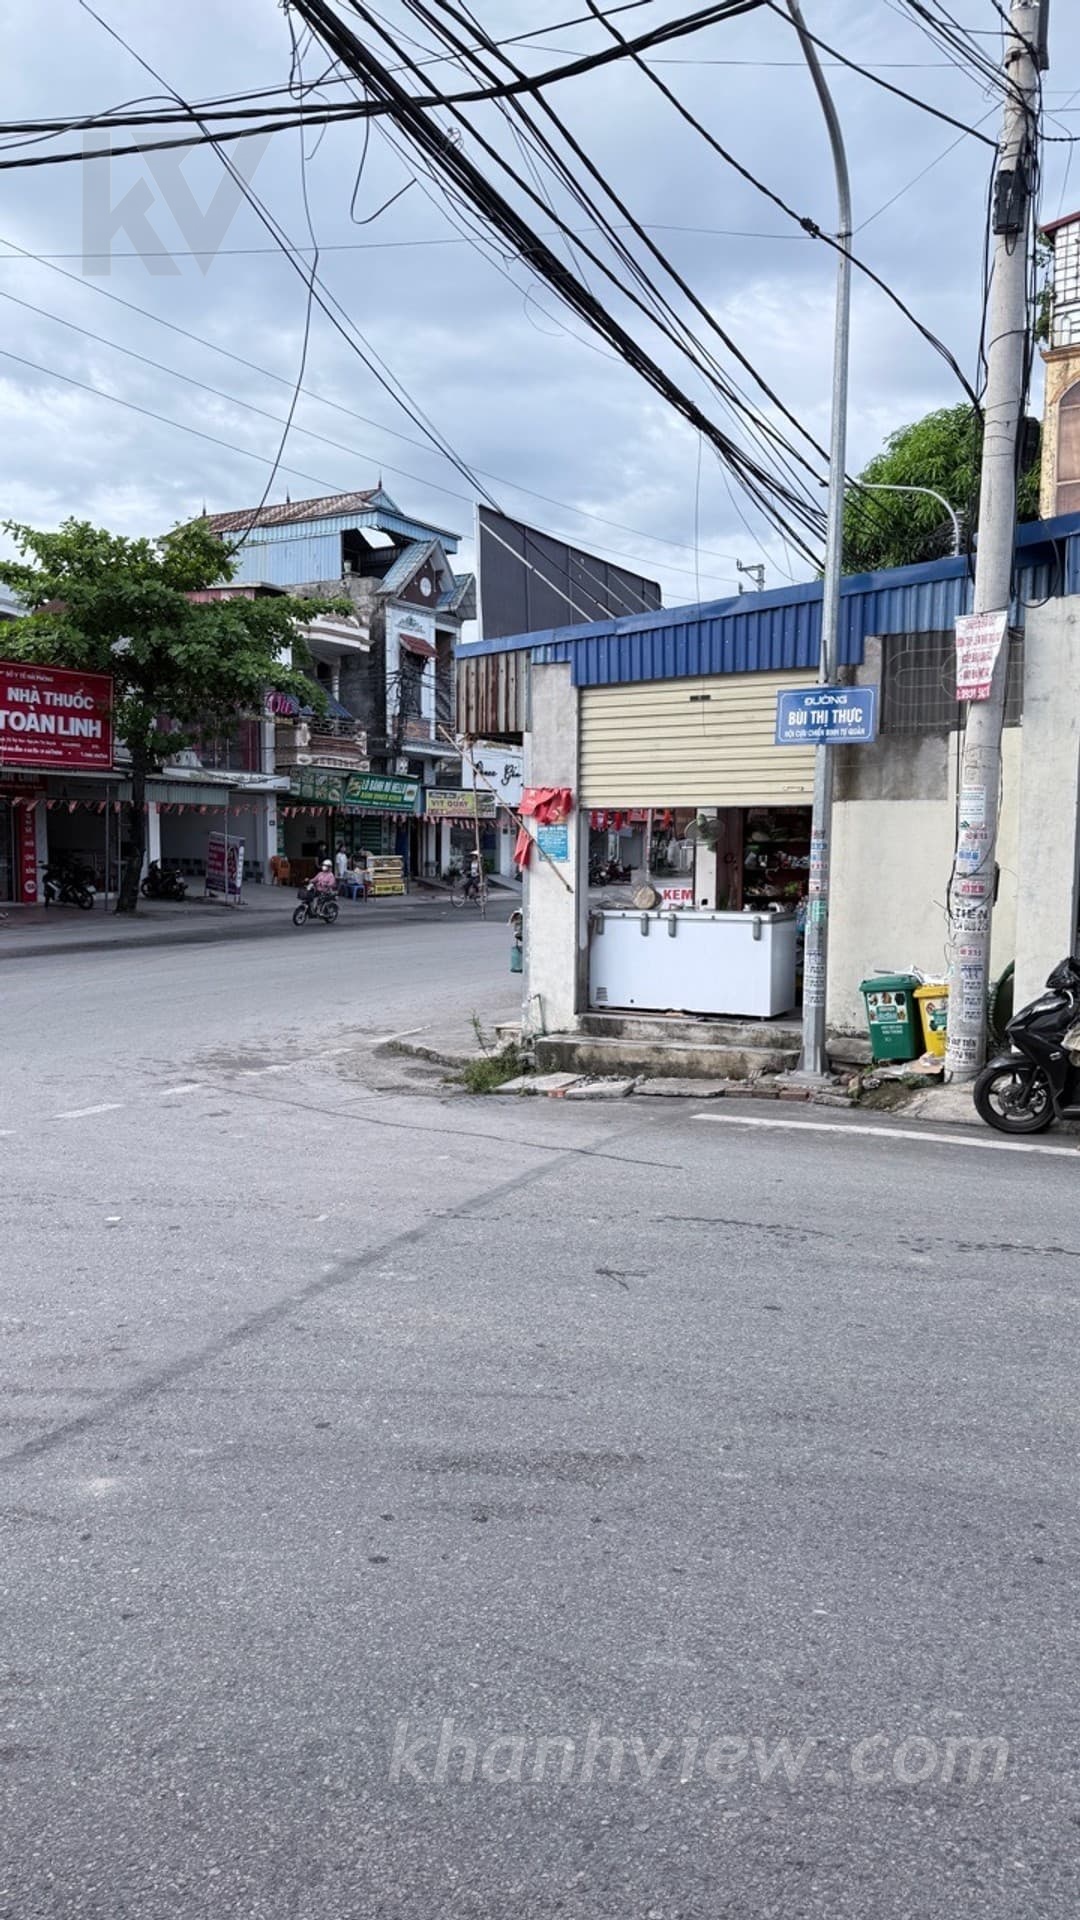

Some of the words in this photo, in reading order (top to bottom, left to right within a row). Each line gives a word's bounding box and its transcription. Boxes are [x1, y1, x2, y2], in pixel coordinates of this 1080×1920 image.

[7, 685, 41, 705] NHÀ
[42, 689, 94, 710] THUỐC
[804, 694, 848, 706] ĐƯỜNG
[0, 705, 55, 734] TOÀN
[57, 716, 102, 739] LINH
[788, 708, 807, 726] BÙI
[810, 710, 828, 727] THỊ
[832, 707, 863, 726] THỰC
[664, 889, 693, 900] KEM
